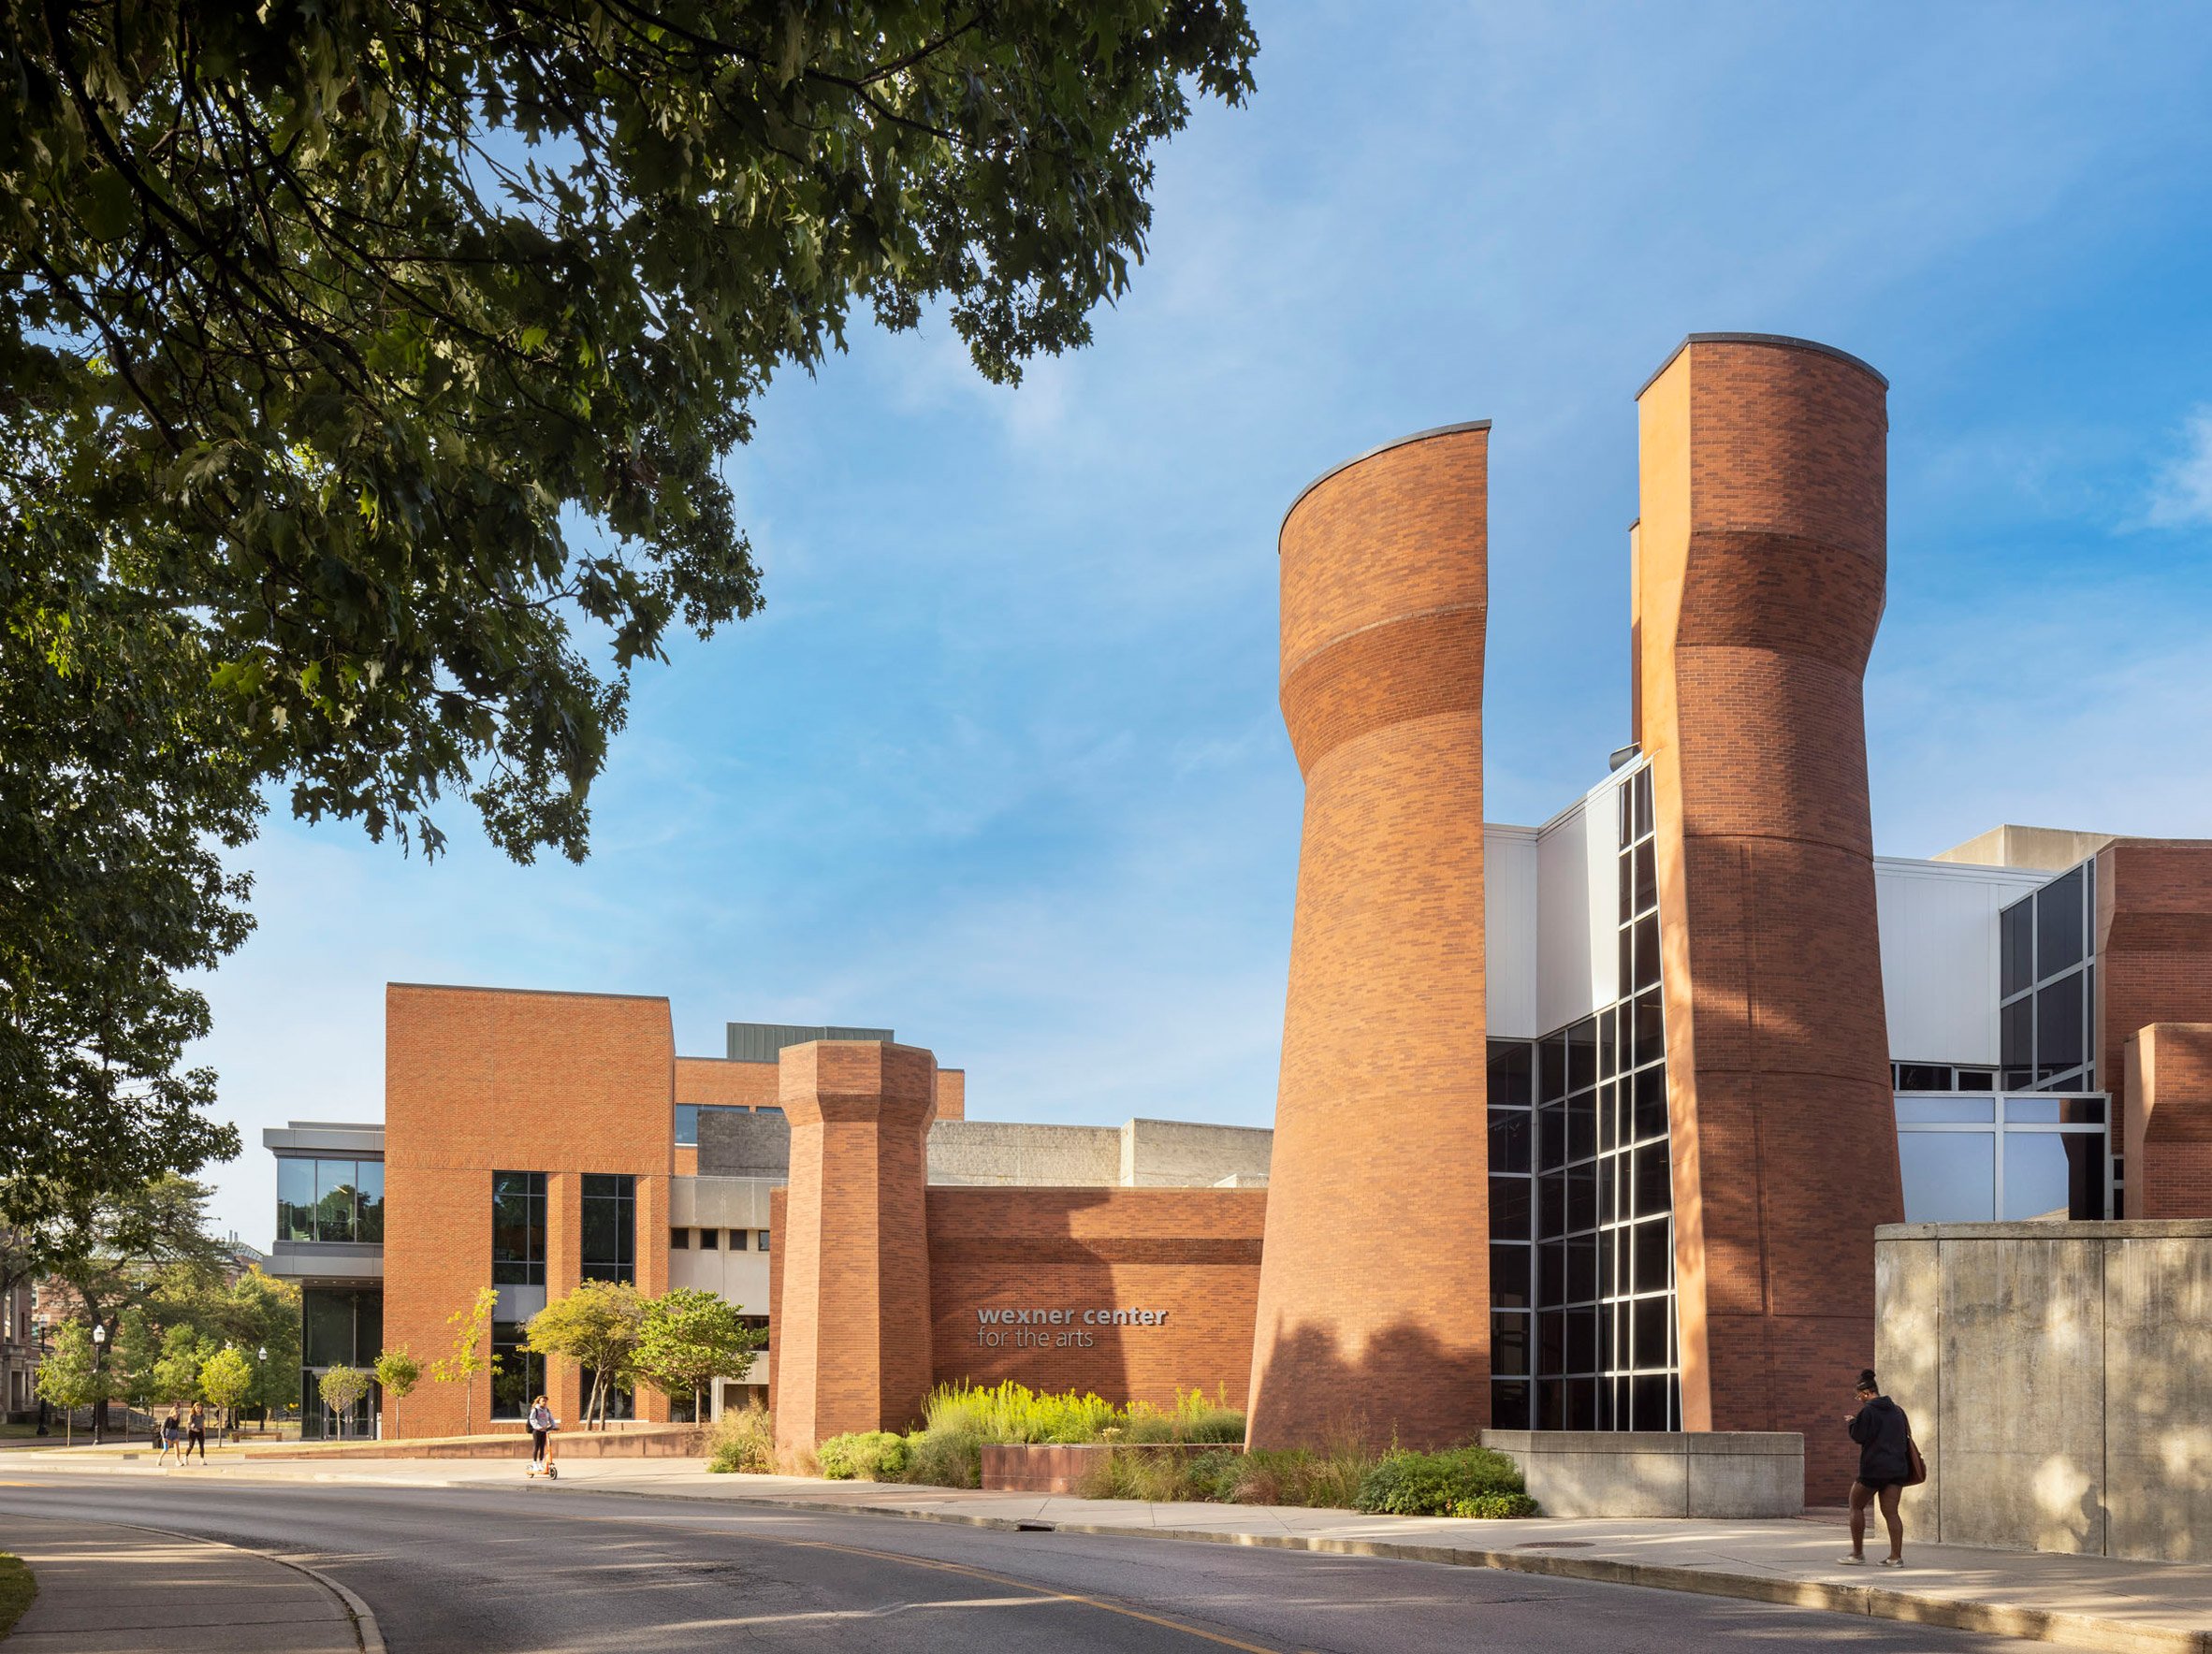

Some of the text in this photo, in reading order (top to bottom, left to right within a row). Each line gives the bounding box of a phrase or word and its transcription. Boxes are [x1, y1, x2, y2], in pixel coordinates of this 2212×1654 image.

[977, 1307, 1168, 1325] wexner center
[977, 1326, 1094, 1347] for the arts
